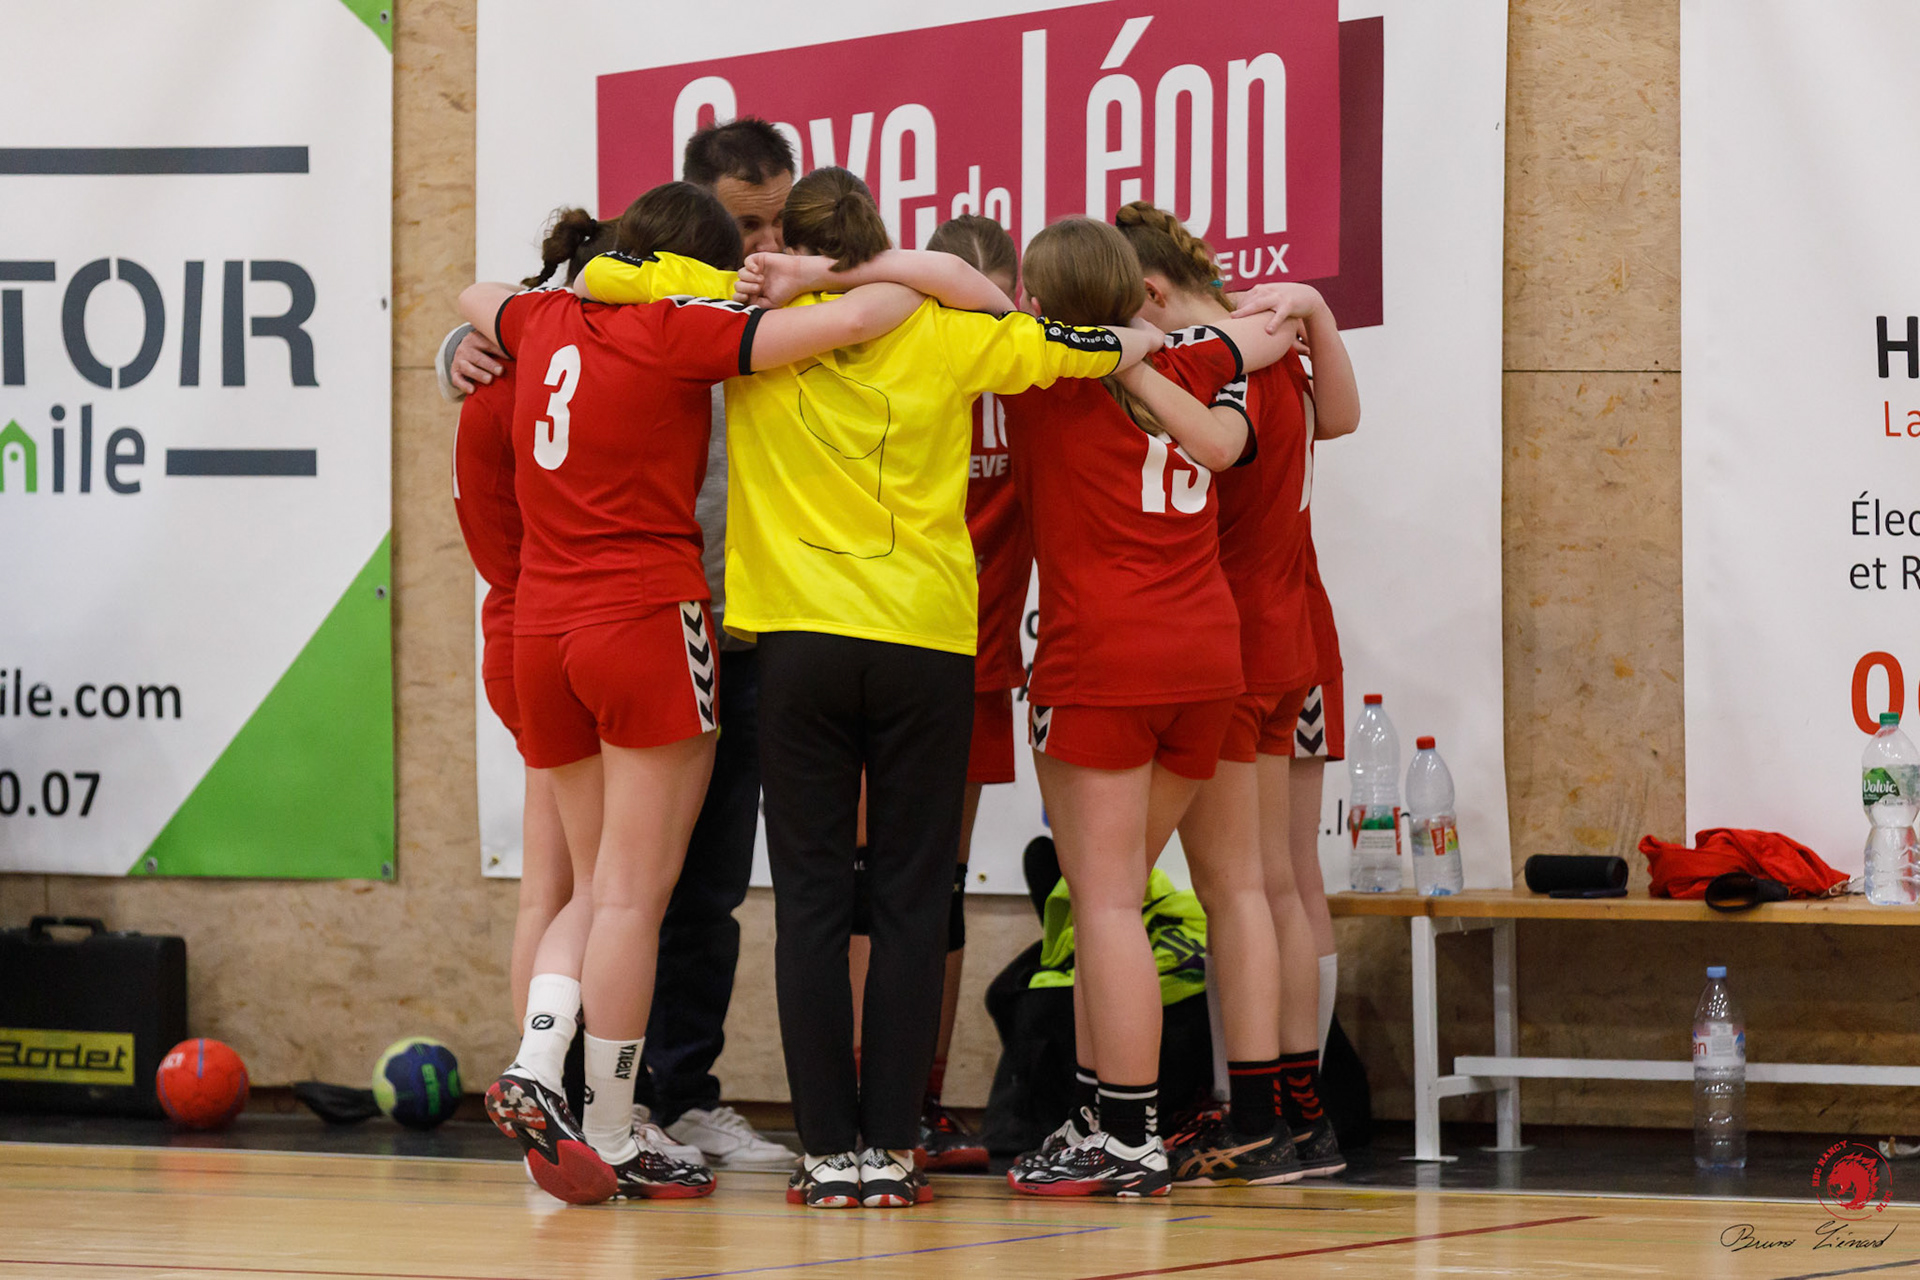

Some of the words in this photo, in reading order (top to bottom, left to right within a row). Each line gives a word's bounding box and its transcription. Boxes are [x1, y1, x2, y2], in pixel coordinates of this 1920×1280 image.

[0, 256, 320, 390] TOIR
[532, 344, 582, 471] 3
[1849, 557, 1888, 590] et
